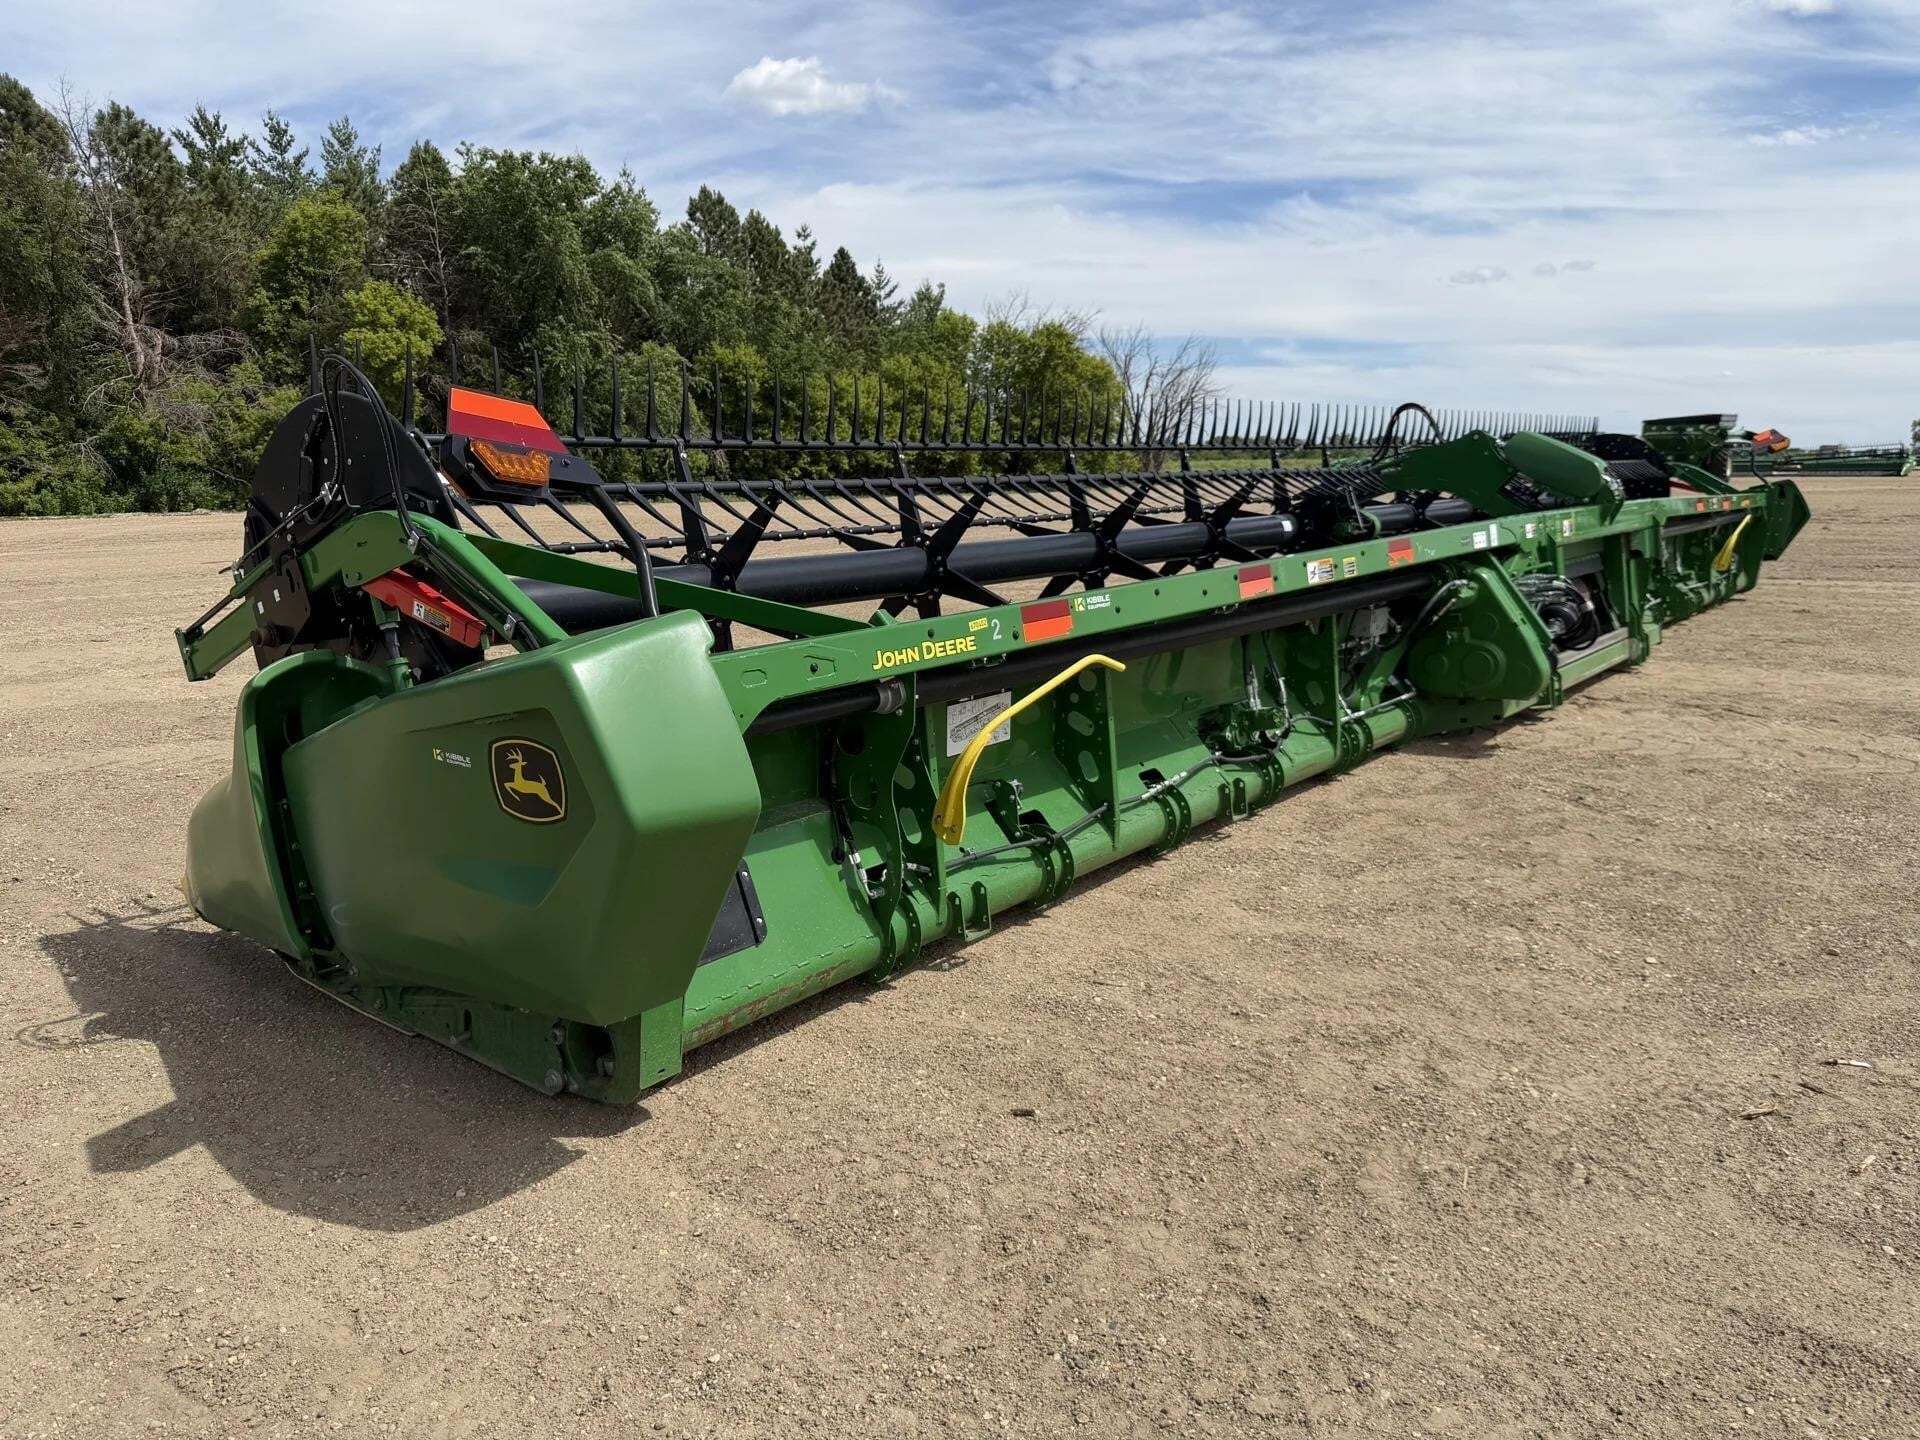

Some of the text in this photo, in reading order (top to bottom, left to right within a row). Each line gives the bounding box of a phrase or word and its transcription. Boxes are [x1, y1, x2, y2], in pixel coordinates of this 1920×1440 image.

[991, 618, 1002, 640] 2
[872, 635, 977, 671] JOHN DEERE
